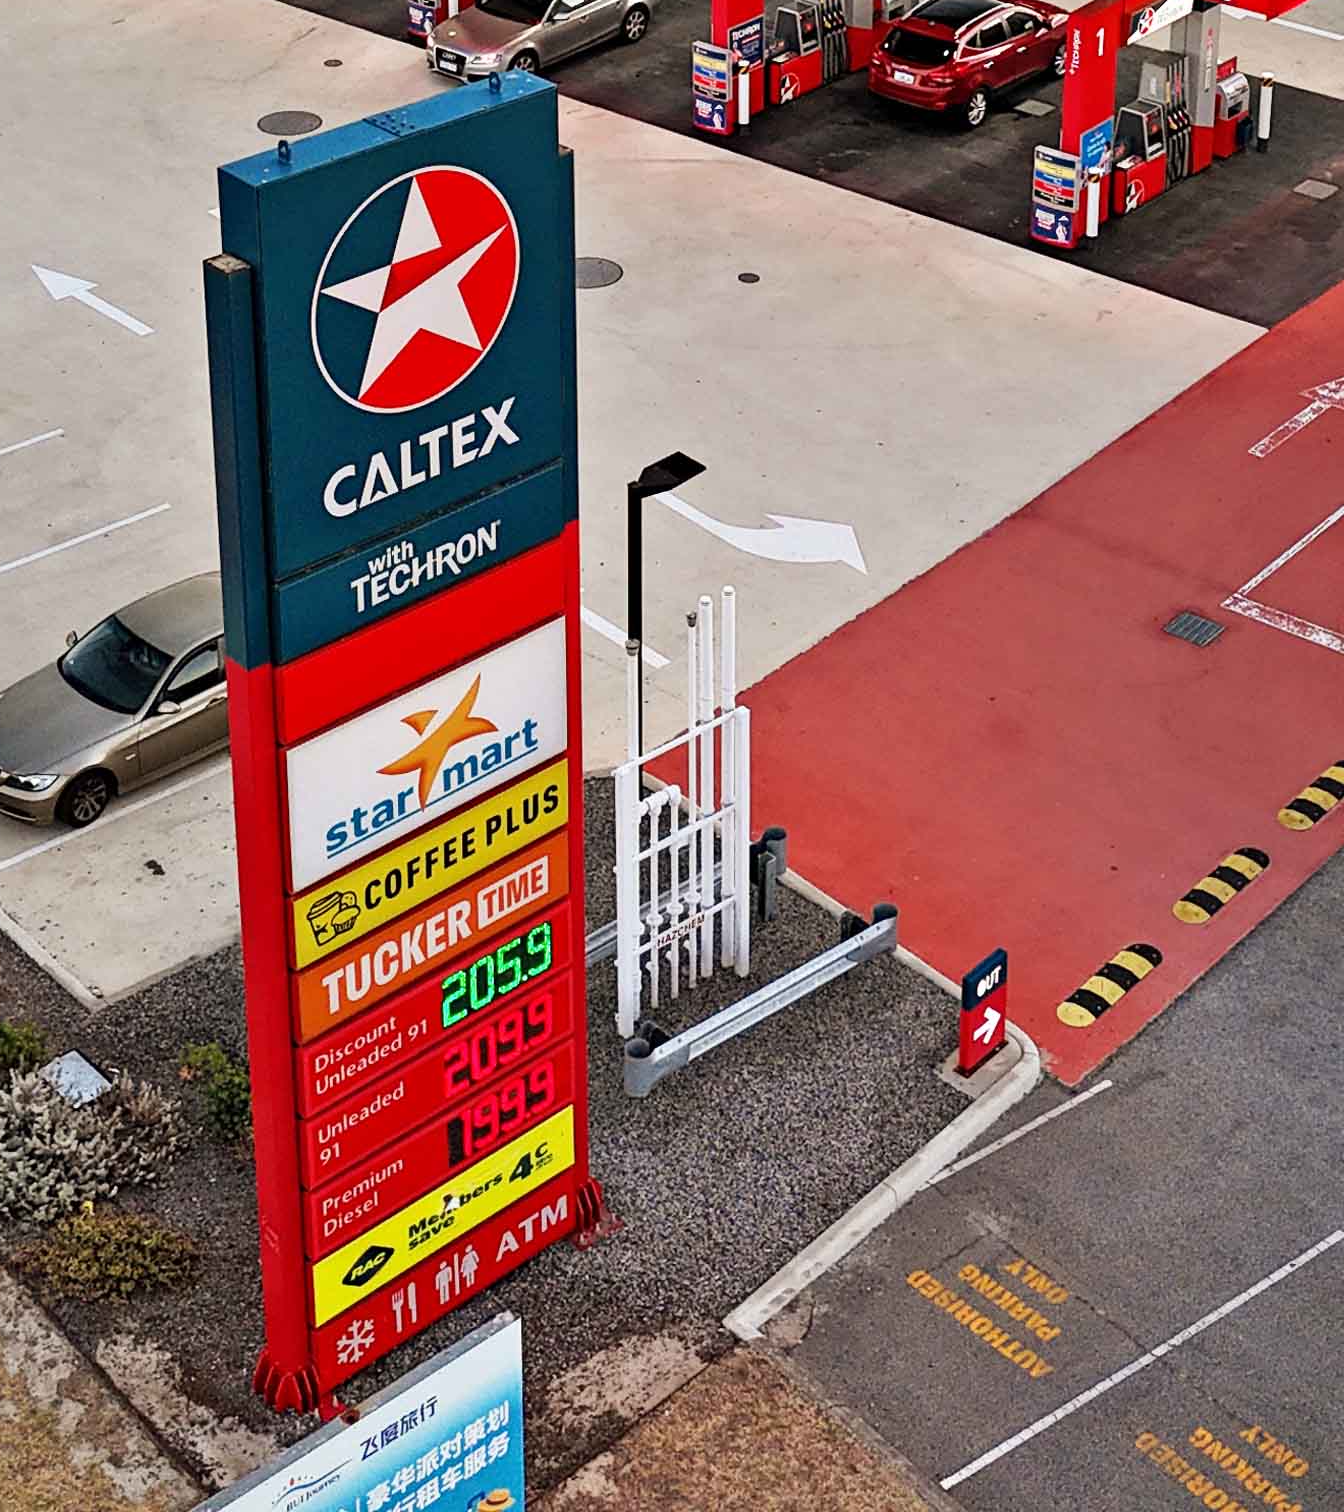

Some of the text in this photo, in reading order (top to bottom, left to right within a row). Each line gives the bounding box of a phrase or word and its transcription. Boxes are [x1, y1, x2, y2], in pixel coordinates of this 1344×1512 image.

[1096, 27, 1105, 56] 1
[323, 396, 522, 518] CALTEX
[350, 523, 498, 614] TECHRON
[367, 541, 415, 577] with
[326, 718, 539, 852] star mart
[364, 784, 560, 910] COFFEE PLUS
[321, 862, 546, 1016] TUCKER TIME
[443, 921, 552, 1028] 205.9
[976, 964, 1002, 997] OUT
[314, 1015, 397, 1074] Discount
[315, 1019, 429, 1096] Unleaded 91
[443, 992, 554, 1099] 209.9
[317, 1081, 405, 1144] Unleaded
[462, 1060, 555, 1159] 199.9
[319, 1143, 341, 1166] 91
[322, 1159, 404, 1215] Premium
[323, 1193, 380, 1238] Diesel
[408, 1172, 504, 1238] Mebers
[408, 1215, 455, 1250] save
[495, 1194, 569, 1262] ATM
[349, 1250, 386, 1282] RAC
[1003, 1259, 1069, 1305] ONLY
[906, 1270, 1054, 1379] AUTHORISED
[958, 1264, 1062, 1342] PARKING
[366, 1399, 510, 1512] 豪华派对策划
[1239, 1425, 1310, 1478] ONLY
